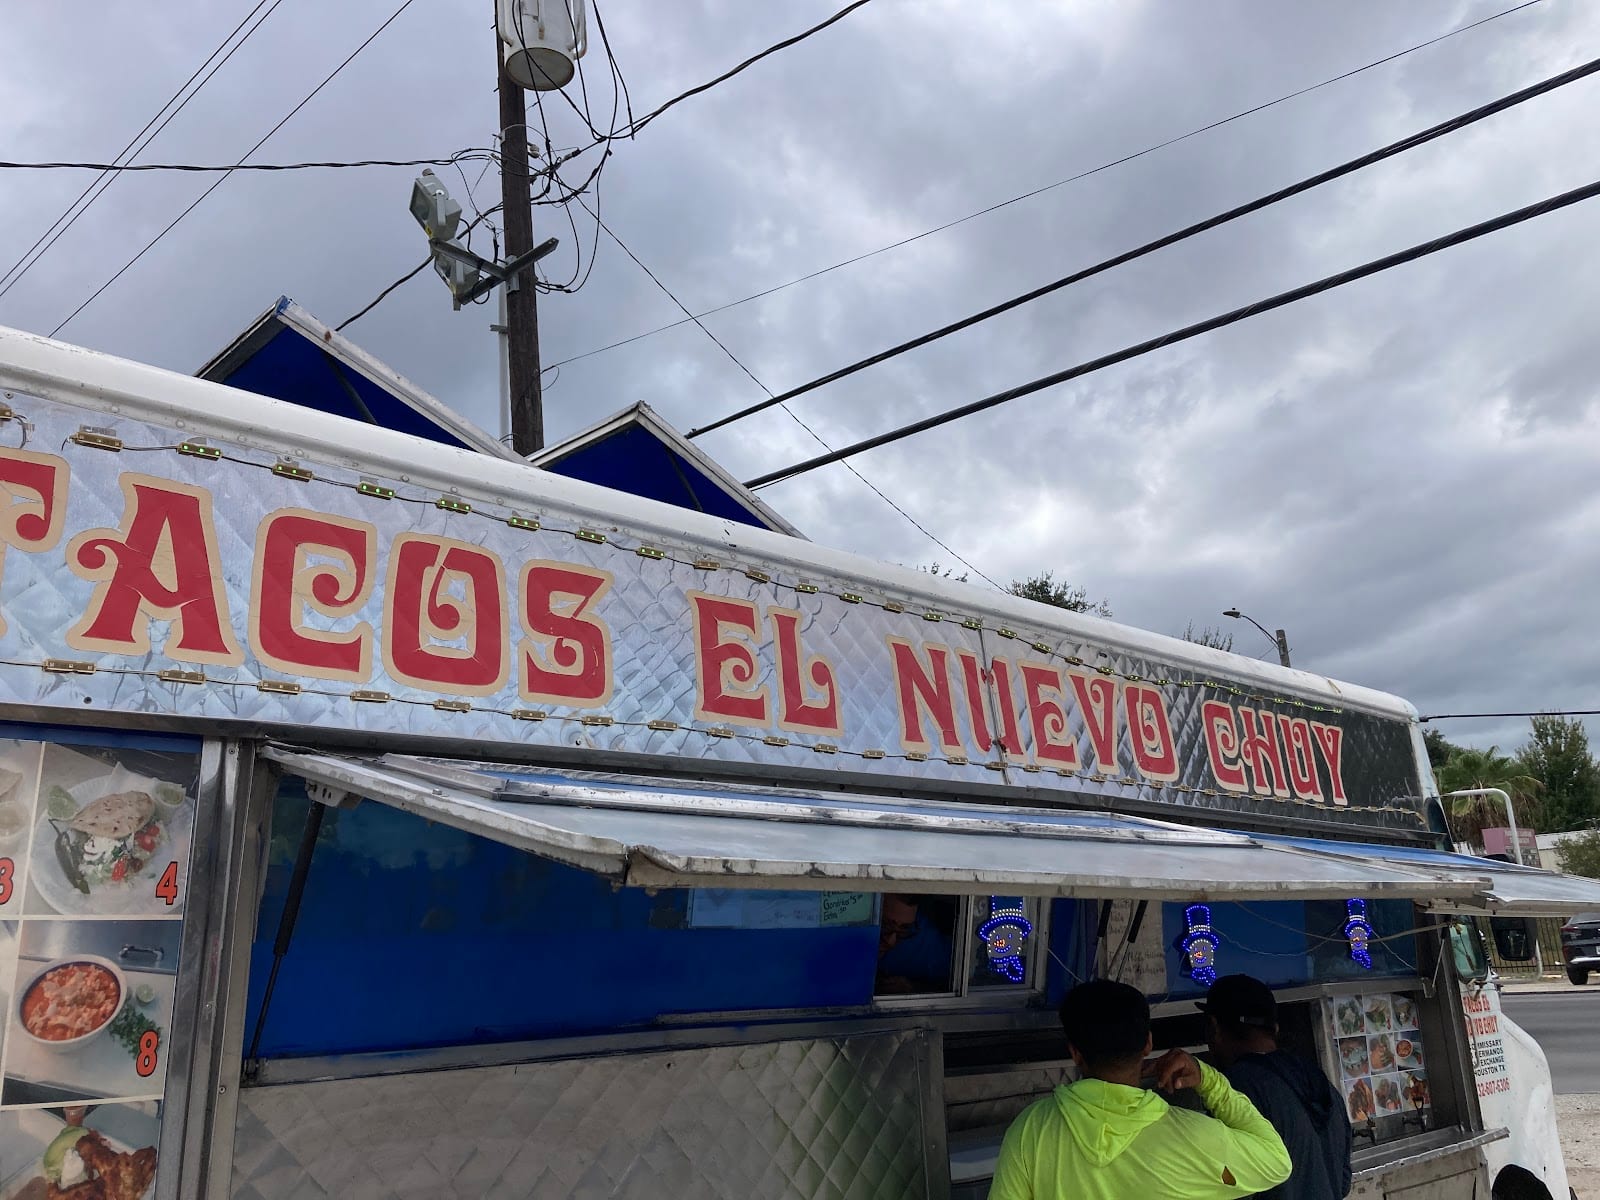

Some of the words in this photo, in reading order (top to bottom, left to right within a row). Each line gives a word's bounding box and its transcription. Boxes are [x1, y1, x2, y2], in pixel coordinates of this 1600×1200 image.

[687, 590, 843, 737] EL
[887, 635, 1179, 782] NUEVO
[1202, 701, 1348, 806] CHUY
[156, 861, 178, 905] 4
[136, 1030, 159, 1076] 8
